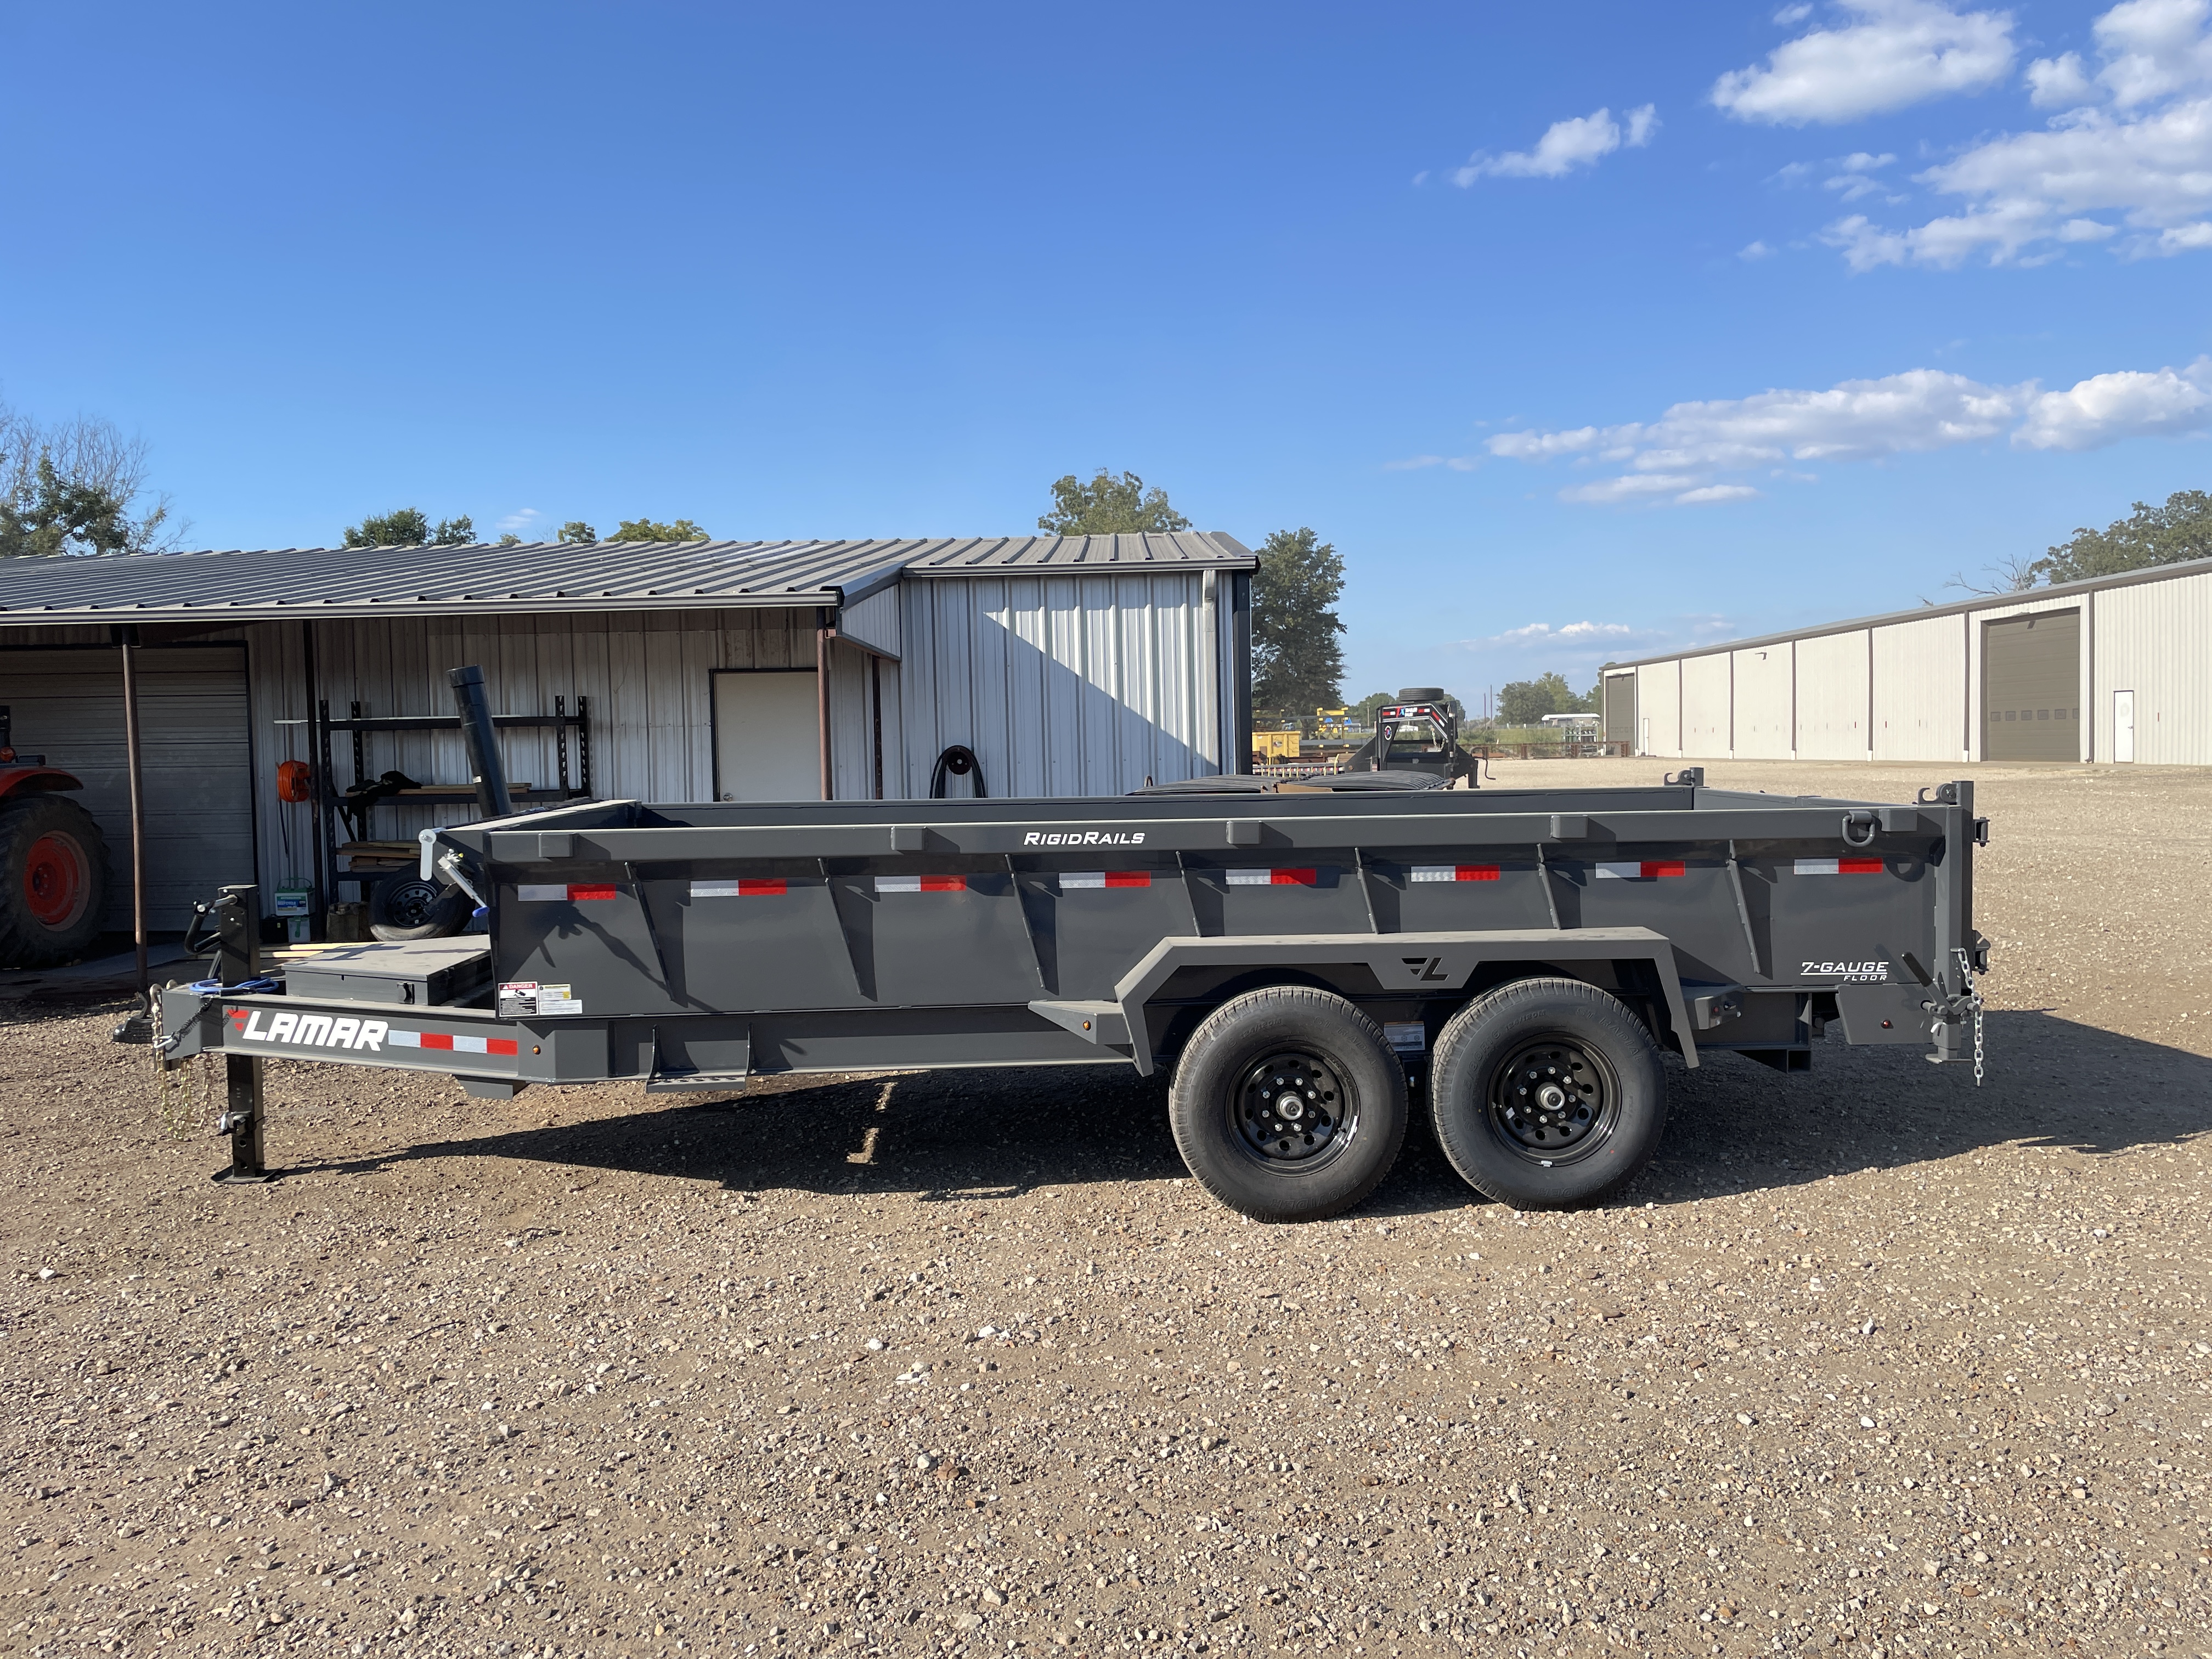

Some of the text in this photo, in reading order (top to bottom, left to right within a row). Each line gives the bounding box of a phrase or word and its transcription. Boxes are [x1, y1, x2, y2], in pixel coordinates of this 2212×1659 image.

[1802, 962, 1889, 973] 7-GAUGE
[242, 1011, 388, 1051] LAMAR
[1599, 1017, 1643, 1063] RADIAL
[1337, 1027, 1381, 1074] RADIAL
[1270, 1175, 1362, 1210] PROVIDER
[1538, 1163, 1624, 1198] PROVIDER
